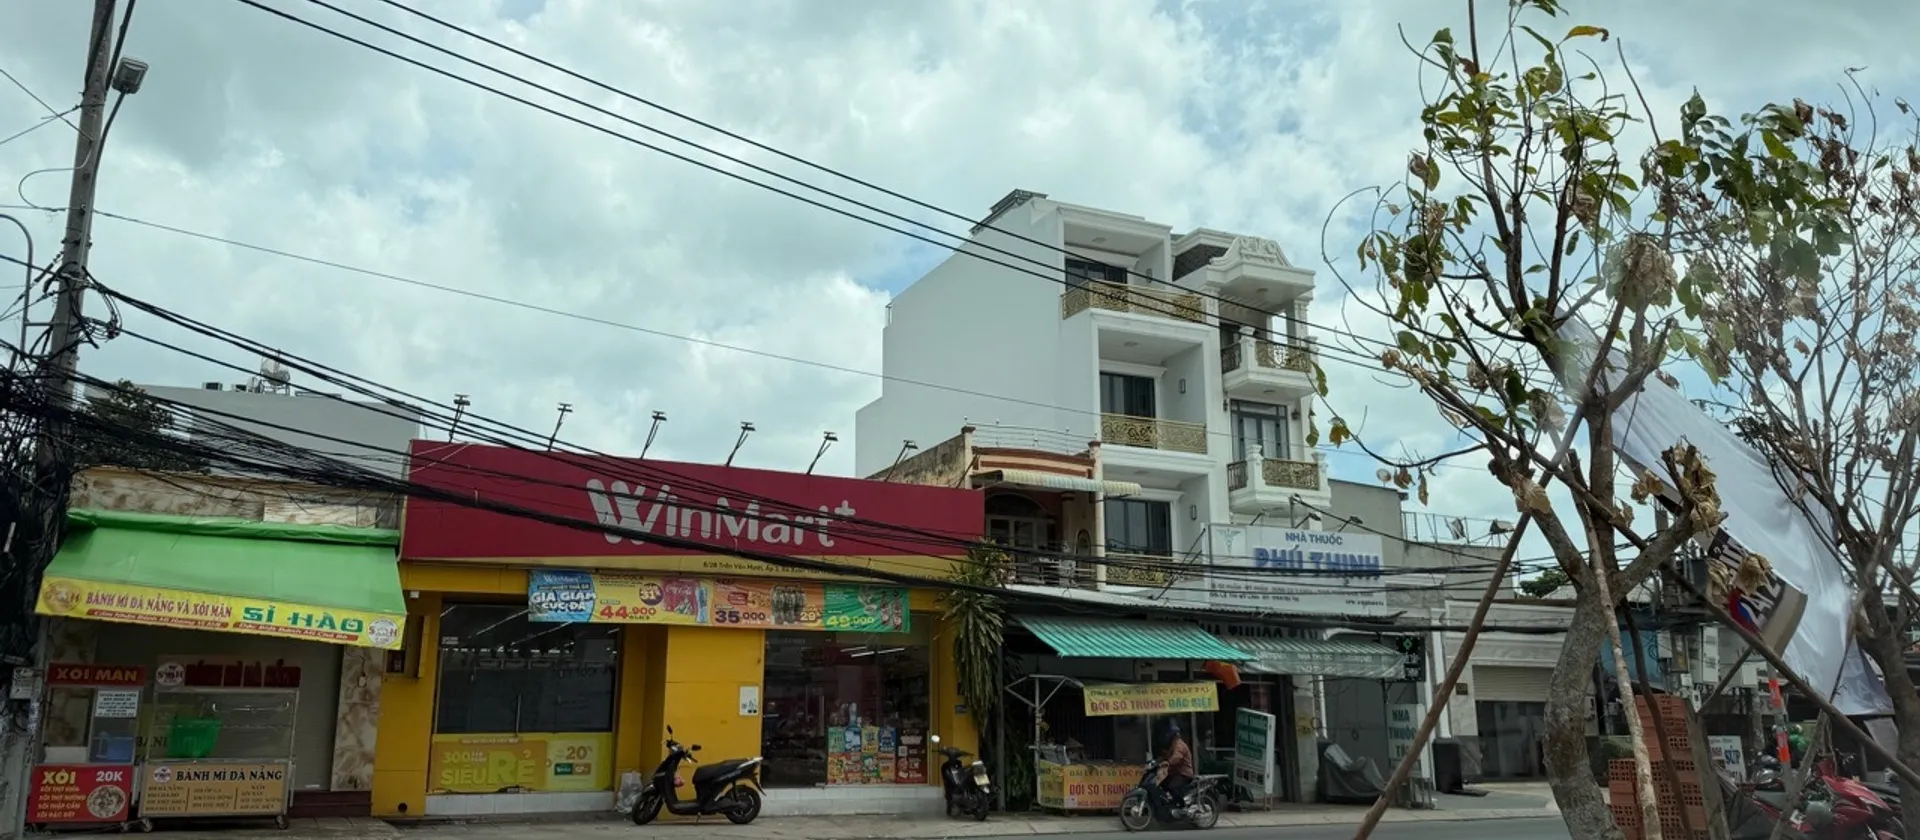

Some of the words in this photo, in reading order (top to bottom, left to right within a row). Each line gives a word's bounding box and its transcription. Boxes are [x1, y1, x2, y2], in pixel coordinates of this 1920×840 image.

[586, 478, 856, 548] WinMart+
[1286, 532, 1307, 543] NHÀ
[1309, 531, 1343, 545] THUỐC
[1254, 544, 1303, 576] PHÚ
[86, 590, 116, 605] BÁNH
[42, 768, 77, 784] XÔI
[95, 771, 124, 782] 20K
[176, 767, 210, 781] BÁNH
[213, 768, 227, 781] MÌ
